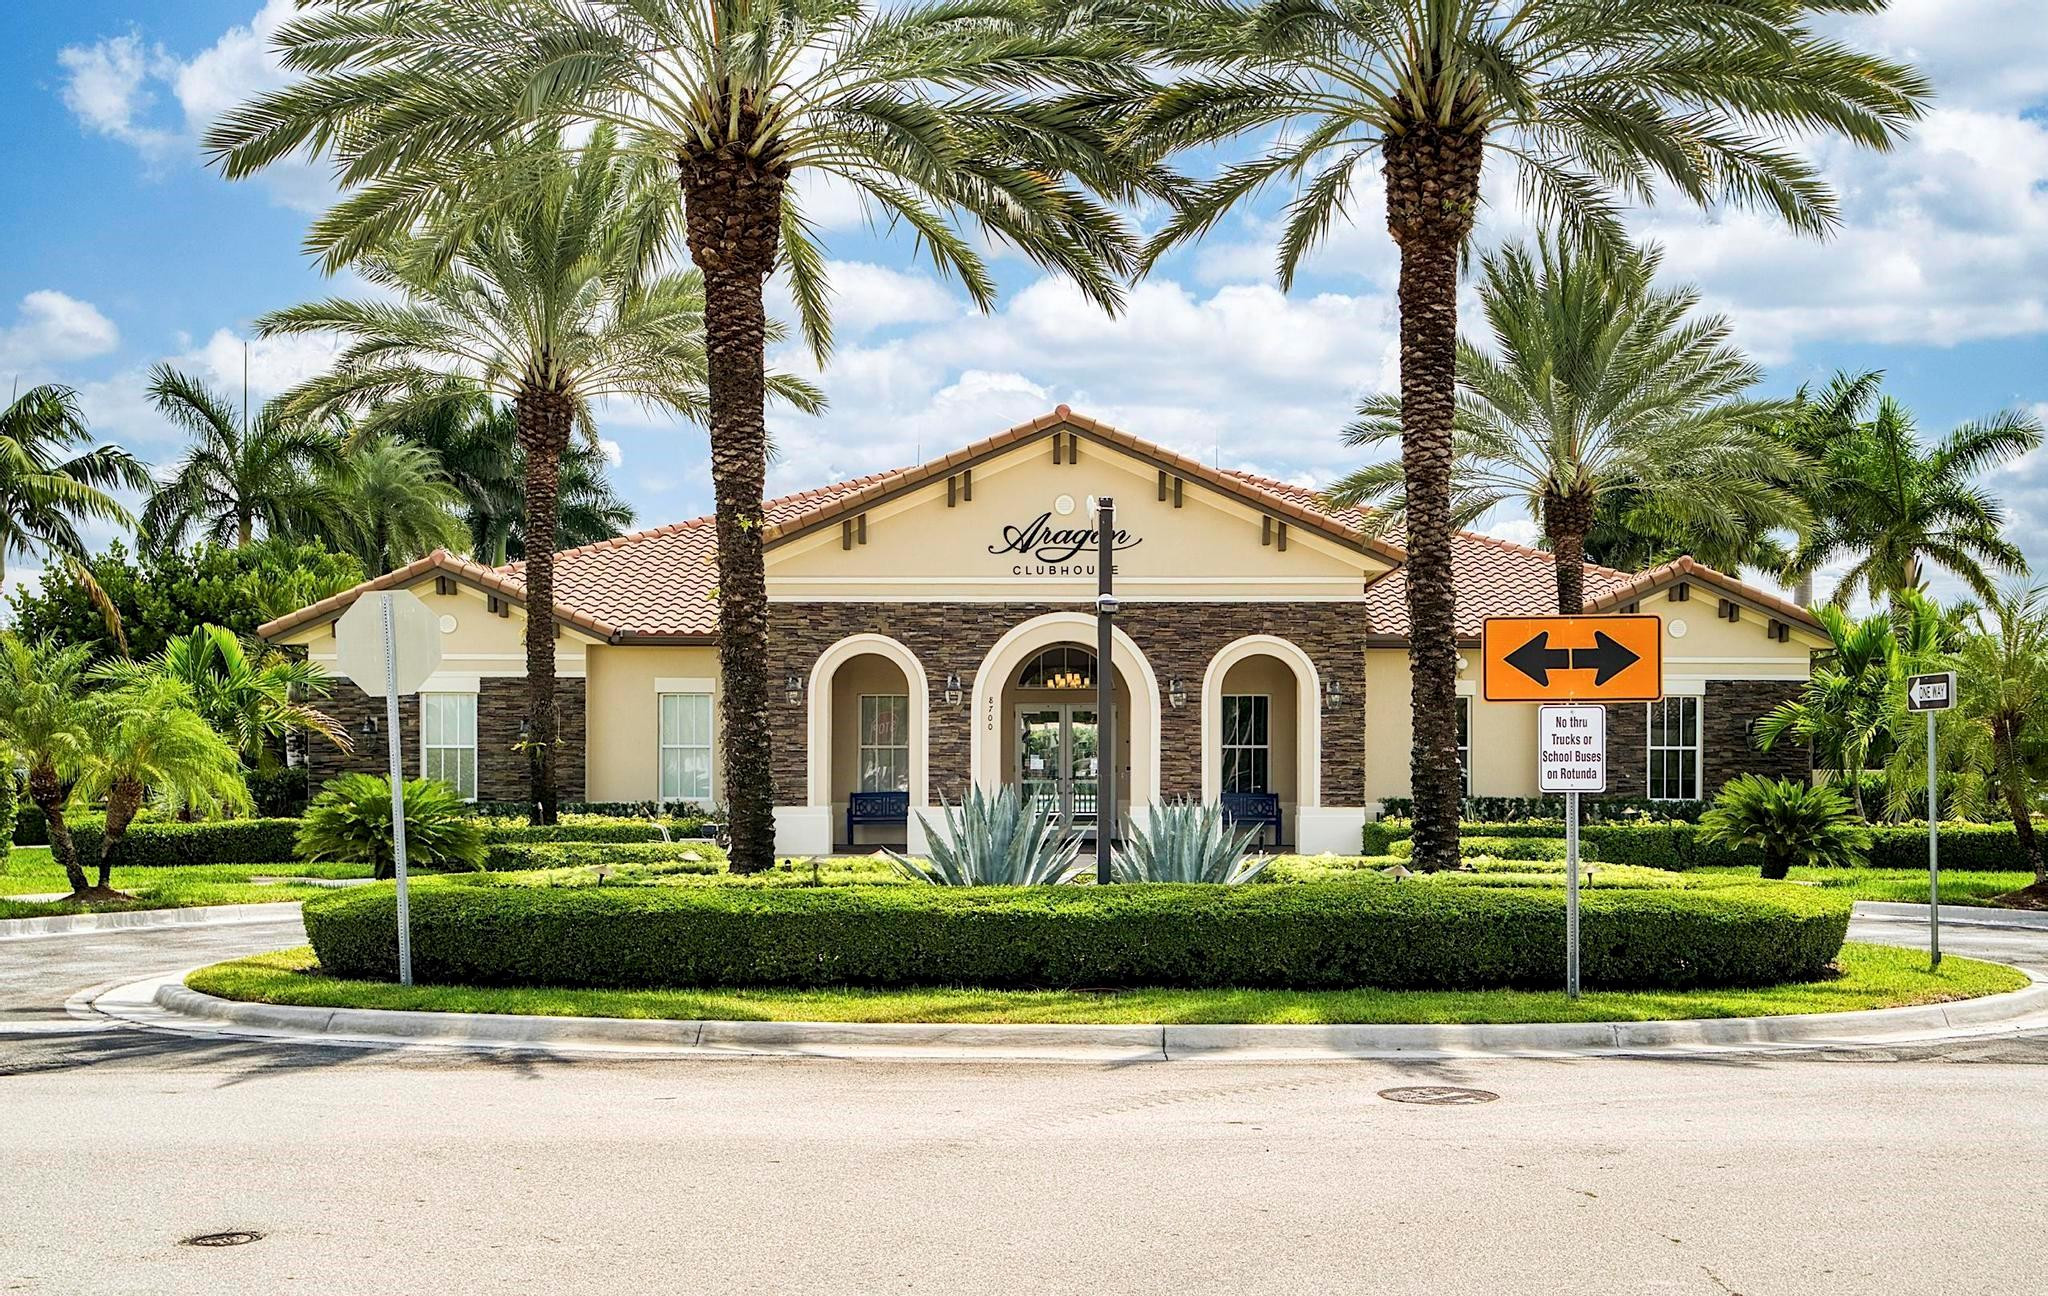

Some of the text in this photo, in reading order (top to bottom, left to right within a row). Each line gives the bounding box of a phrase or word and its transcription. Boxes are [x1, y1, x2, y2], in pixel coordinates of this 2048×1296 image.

[1013, 565, 1119, 575] CLUBHOUE
[1920, 684, 1946, 699] ONE WAY
[1556, 716, 1588, 728] No thru
[1551, 733, 1592, 745] Trucks or
[1542, 750, 1602, 763] School Buses
[1547, 767, 1597, 780] on Rotunda
